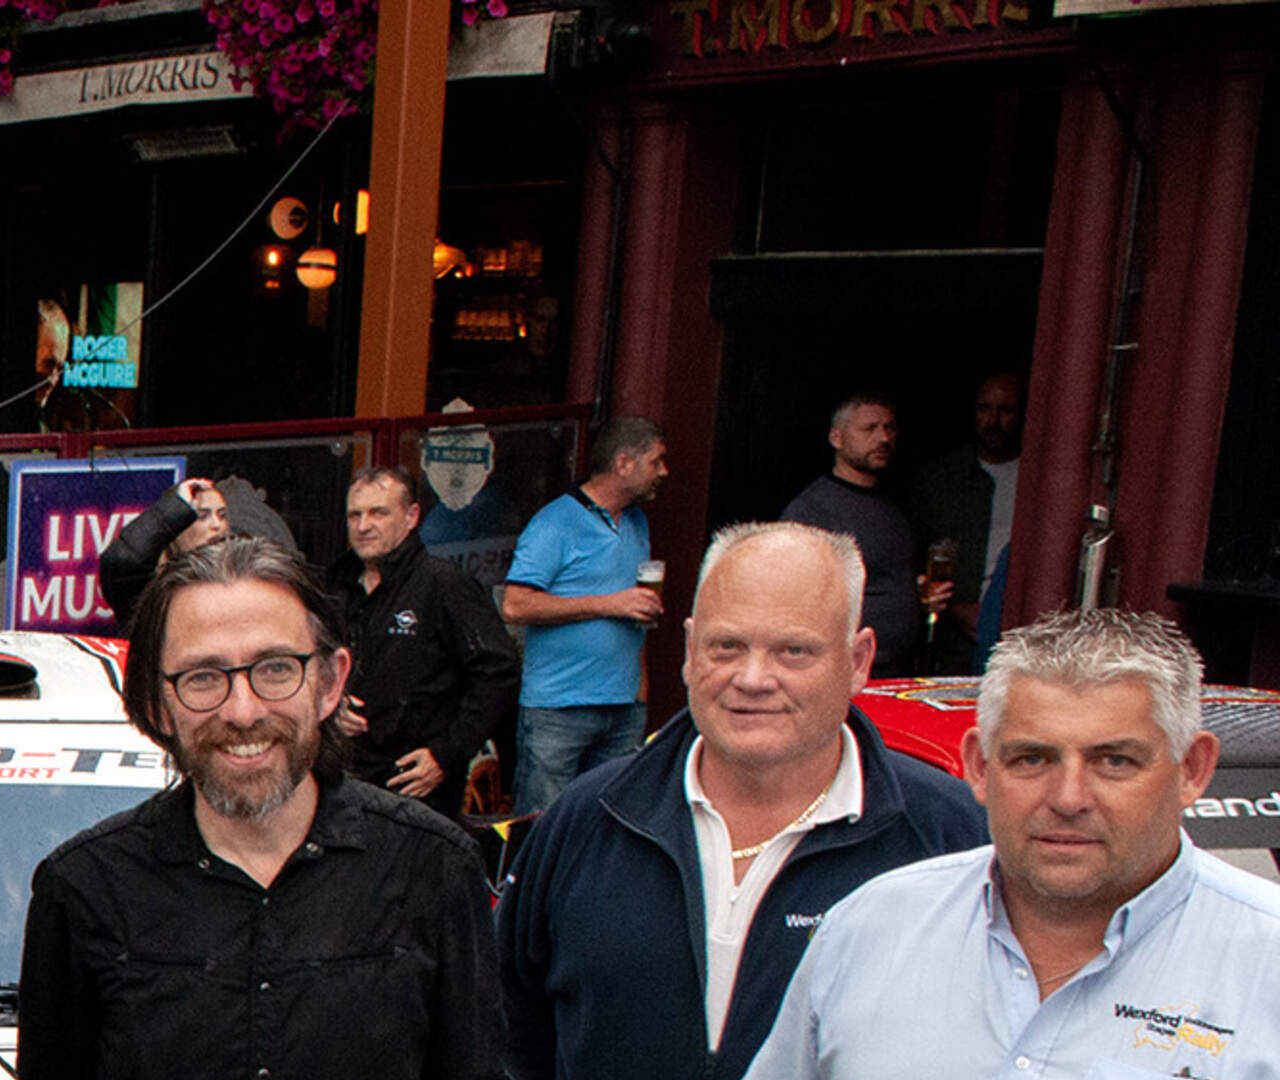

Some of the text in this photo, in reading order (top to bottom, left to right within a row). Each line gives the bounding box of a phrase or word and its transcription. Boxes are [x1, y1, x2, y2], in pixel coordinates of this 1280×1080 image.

[72, 334, 128, 361] ROGER
[62, 361, 137, 388] MCGUIRE
[48, 512, 141, 561] LIV
[1114, 1003, 1183, 1029] Wexford
[1176, 1024, 1228, 1057] Rally
